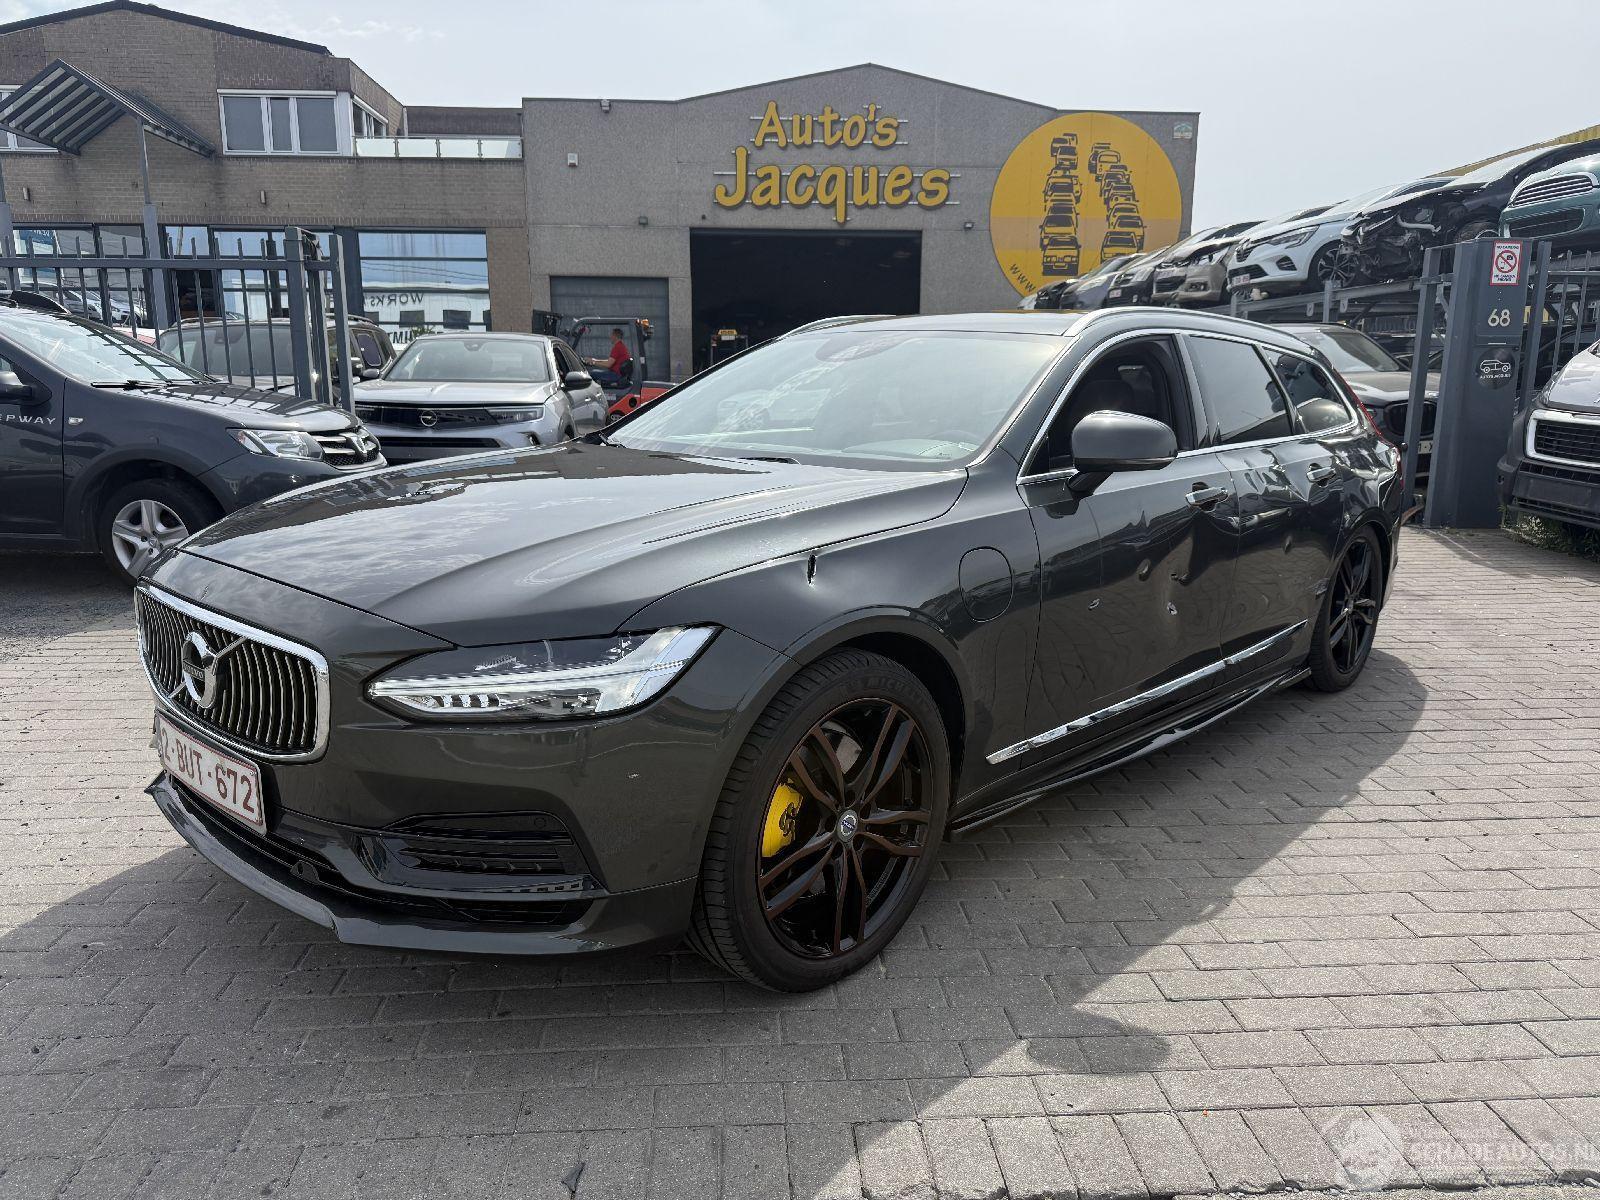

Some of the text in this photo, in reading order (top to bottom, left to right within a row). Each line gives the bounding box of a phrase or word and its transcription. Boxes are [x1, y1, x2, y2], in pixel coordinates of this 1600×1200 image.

[754, 100, 899, 148] Auto's
[715, 146, 950, 223] Jacques
[1487, 308, 1511, 327] 68
[0, 413, 56, 425] PWAY
[161, 727, 255, 814] 2-BUT-672
